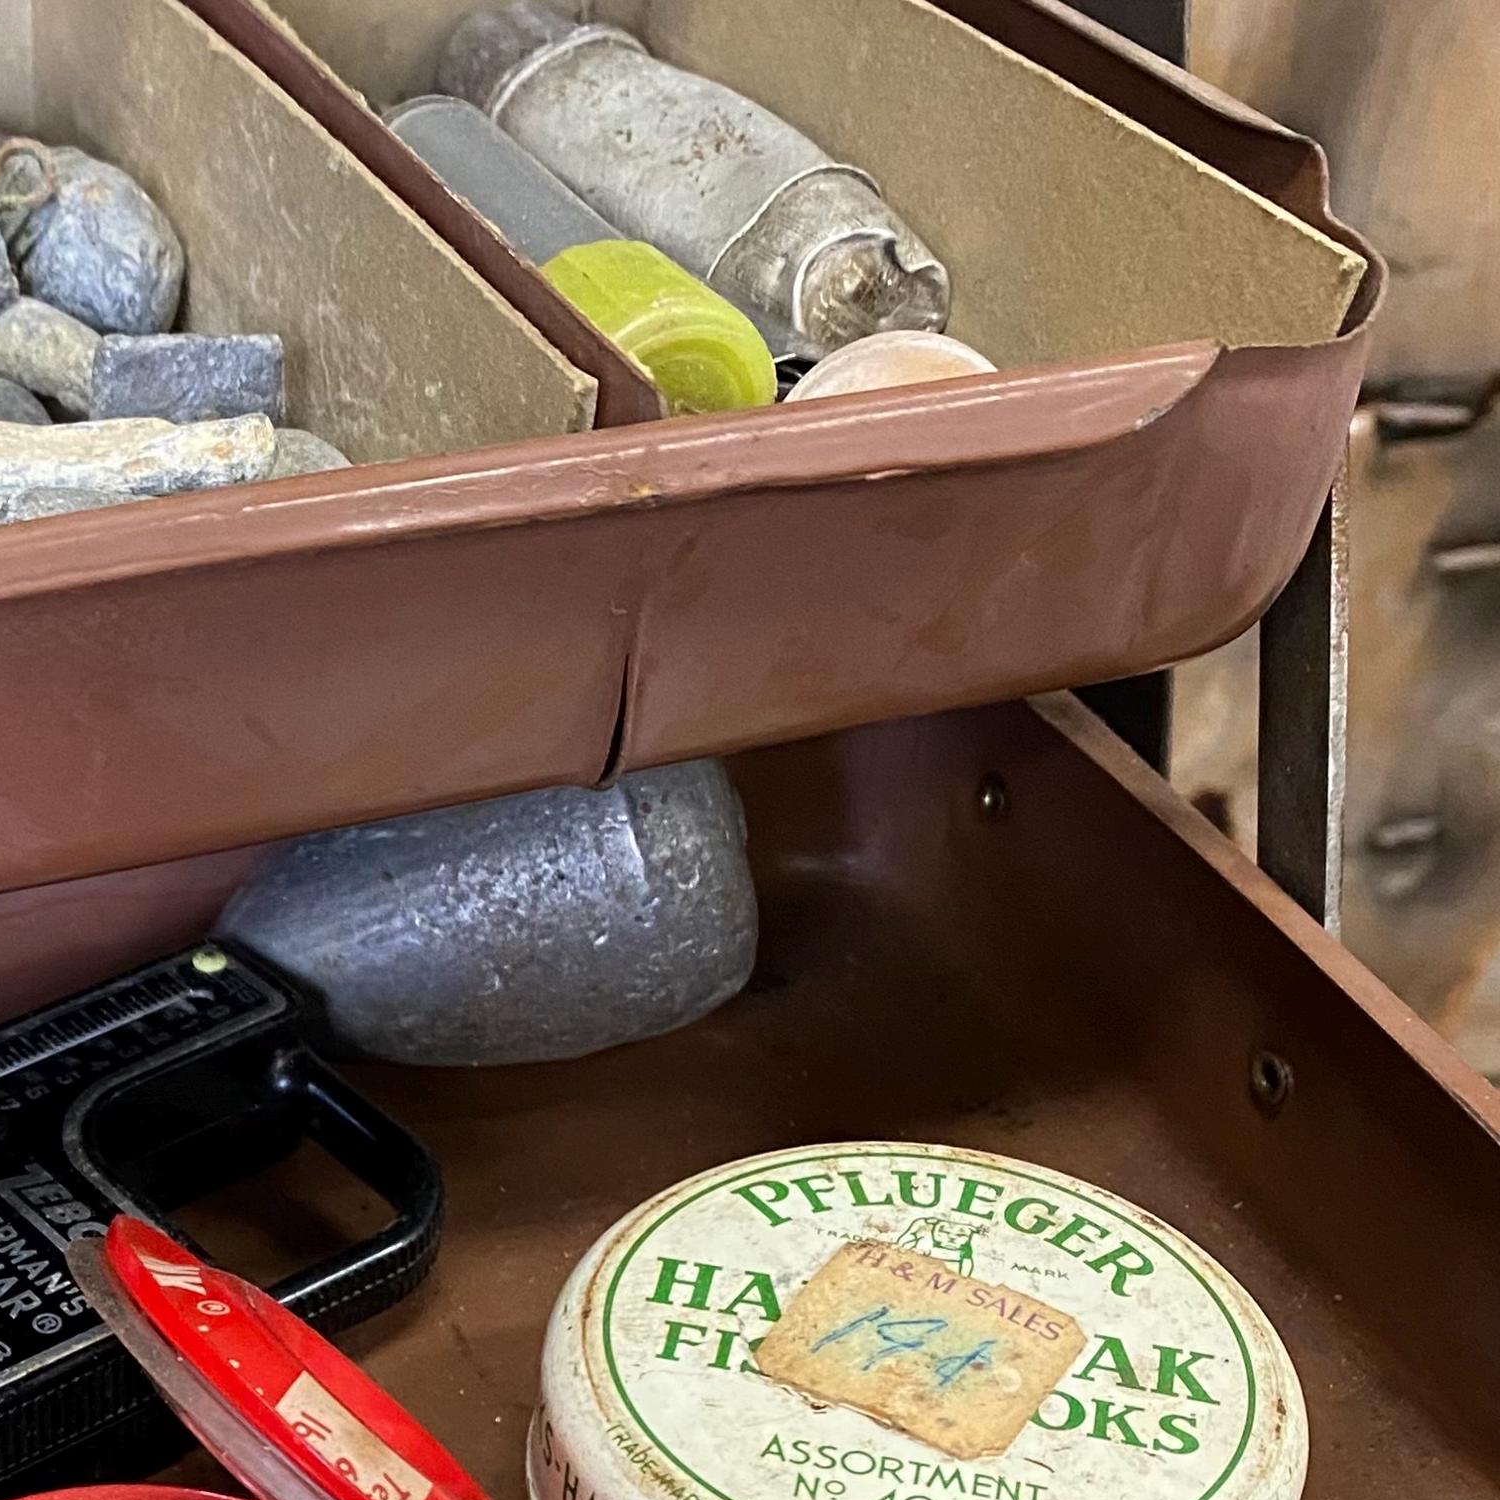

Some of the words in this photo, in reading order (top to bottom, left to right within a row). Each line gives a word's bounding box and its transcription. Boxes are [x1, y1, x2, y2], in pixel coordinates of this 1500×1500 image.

[730, 1169, 1155, 1297] PFLUEGER
[1011, 1262, 1071, 1281] MARK
[926, 1272, 960, 1295] M
[966, 1287, 1065, 1342] SALES
[605, 1421, 657, 1475] TRADE
